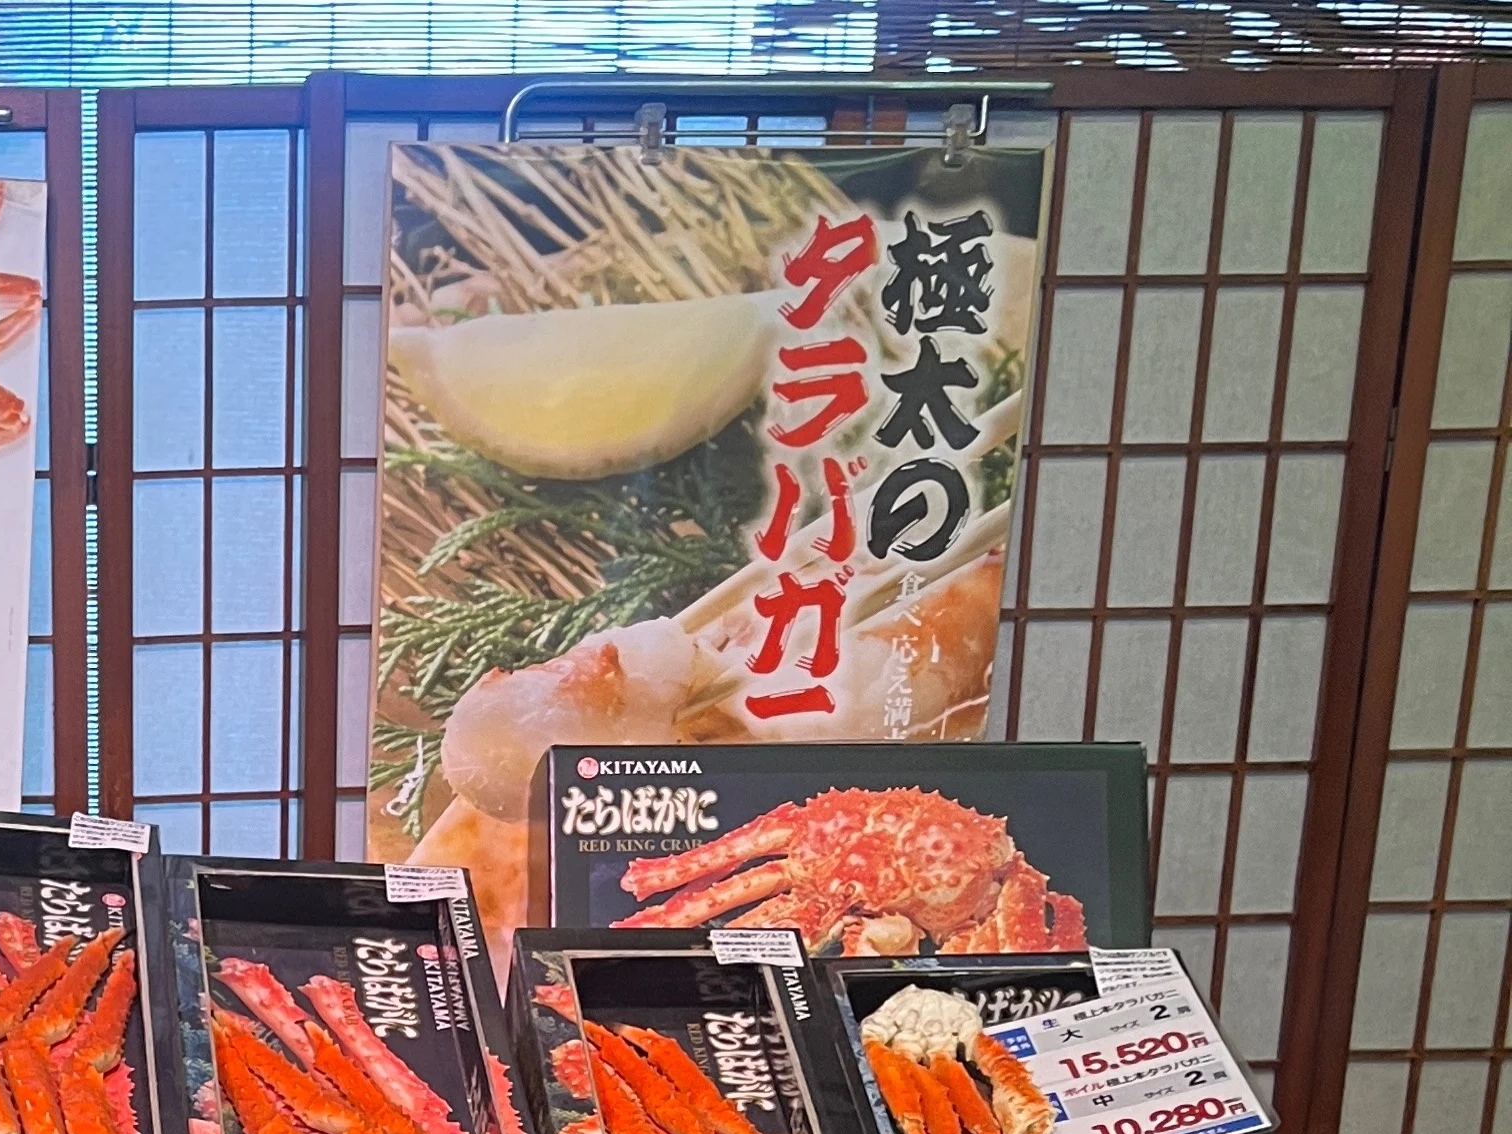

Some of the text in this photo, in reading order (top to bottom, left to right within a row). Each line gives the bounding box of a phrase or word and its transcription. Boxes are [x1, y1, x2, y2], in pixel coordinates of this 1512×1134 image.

[866, 208, 995, 562] 極太の
[600, 760, 702, 775] KITAYAMA
[561, 785, 719, 836] たらばがに
[578, 839, 612, 852] RED
[616, 839, 655, 852] KING
[352, 937, 420, 1039] たらばがに
[423, 959, 451, 1031] KITAYAMA
[1059, 1028, 1083, 1043] 大
[1149, 1005, 1171, 1021] 2
[703, 1012, 776, 1111] たらばがに
[1092, 1094, 1115, 1107] 中
[1184, 1070, 1207, 1087] 2
